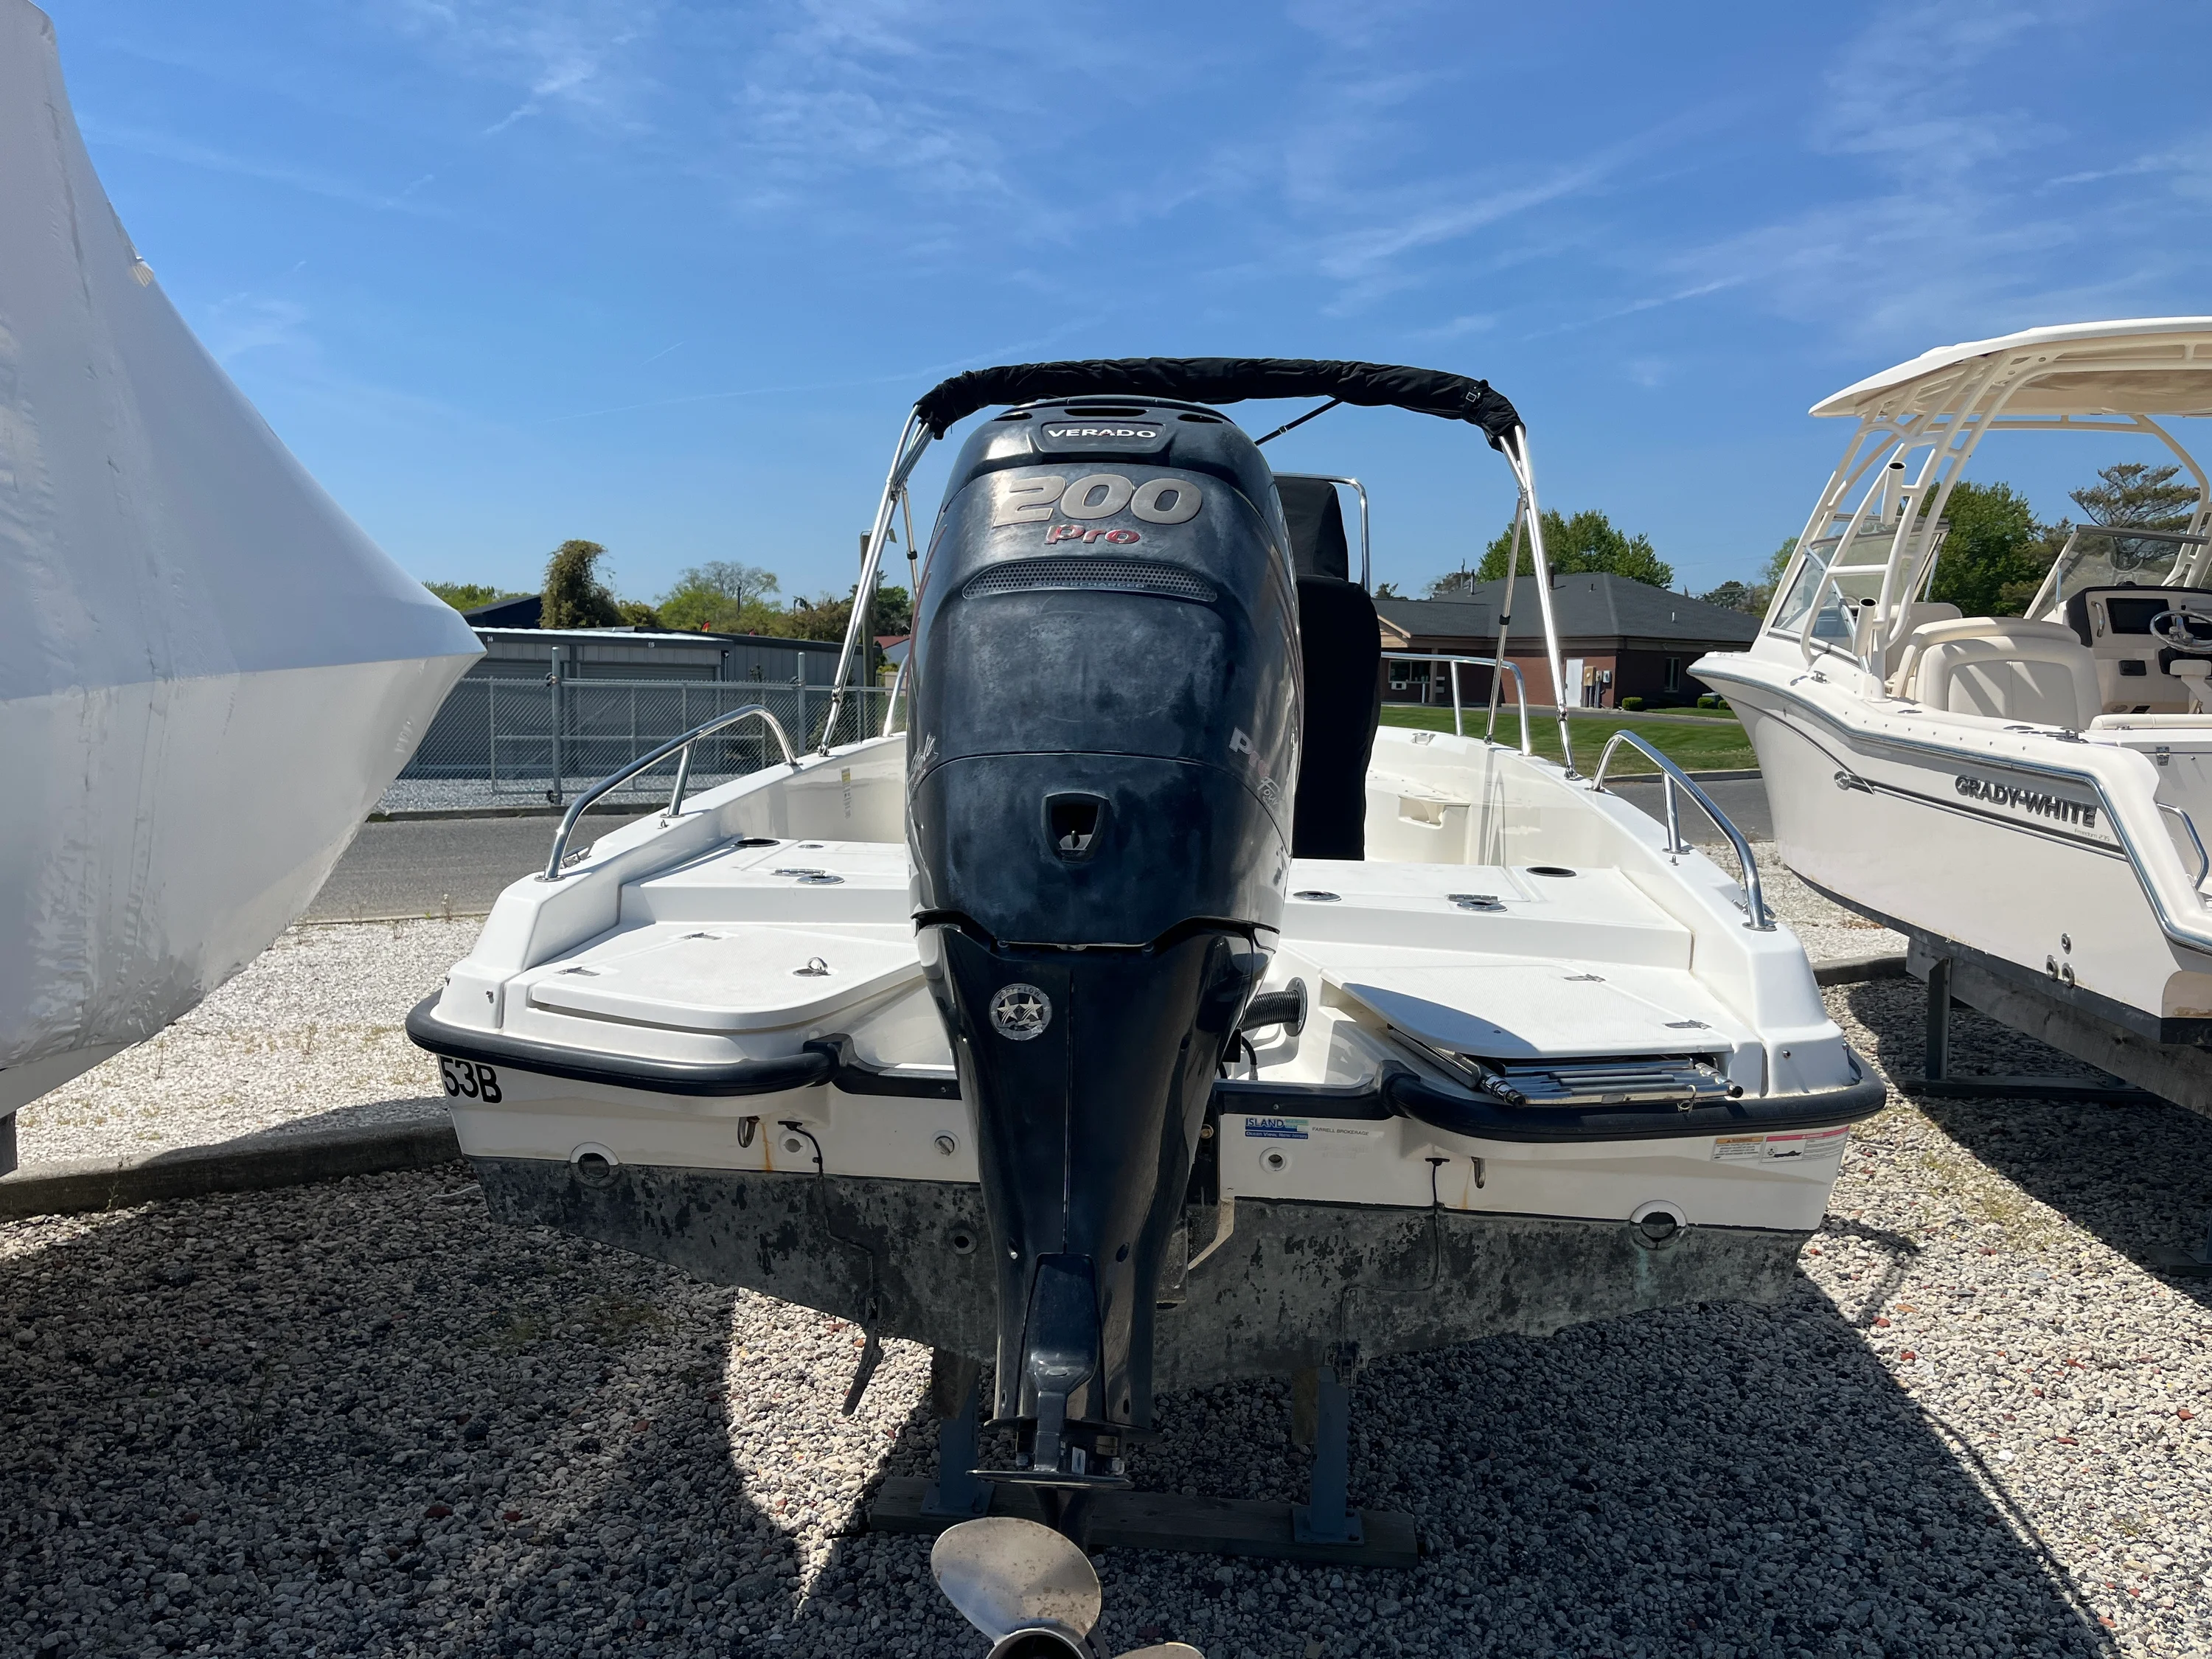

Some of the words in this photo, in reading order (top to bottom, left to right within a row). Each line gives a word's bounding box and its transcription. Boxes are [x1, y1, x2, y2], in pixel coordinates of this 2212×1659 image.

[1048, 428, 1157, 439] VERADO
[992, 474, 1203, 527] 200
[1955, 775, 2098, 828] GRADY-WHITE
[997, 987, 1015, 1000] VERY
[1023, 987, 1041, 997] LOW
[439, 1055, 502, 1103] 53B
[1245, 1118, 1284, 1128] ISLAND
